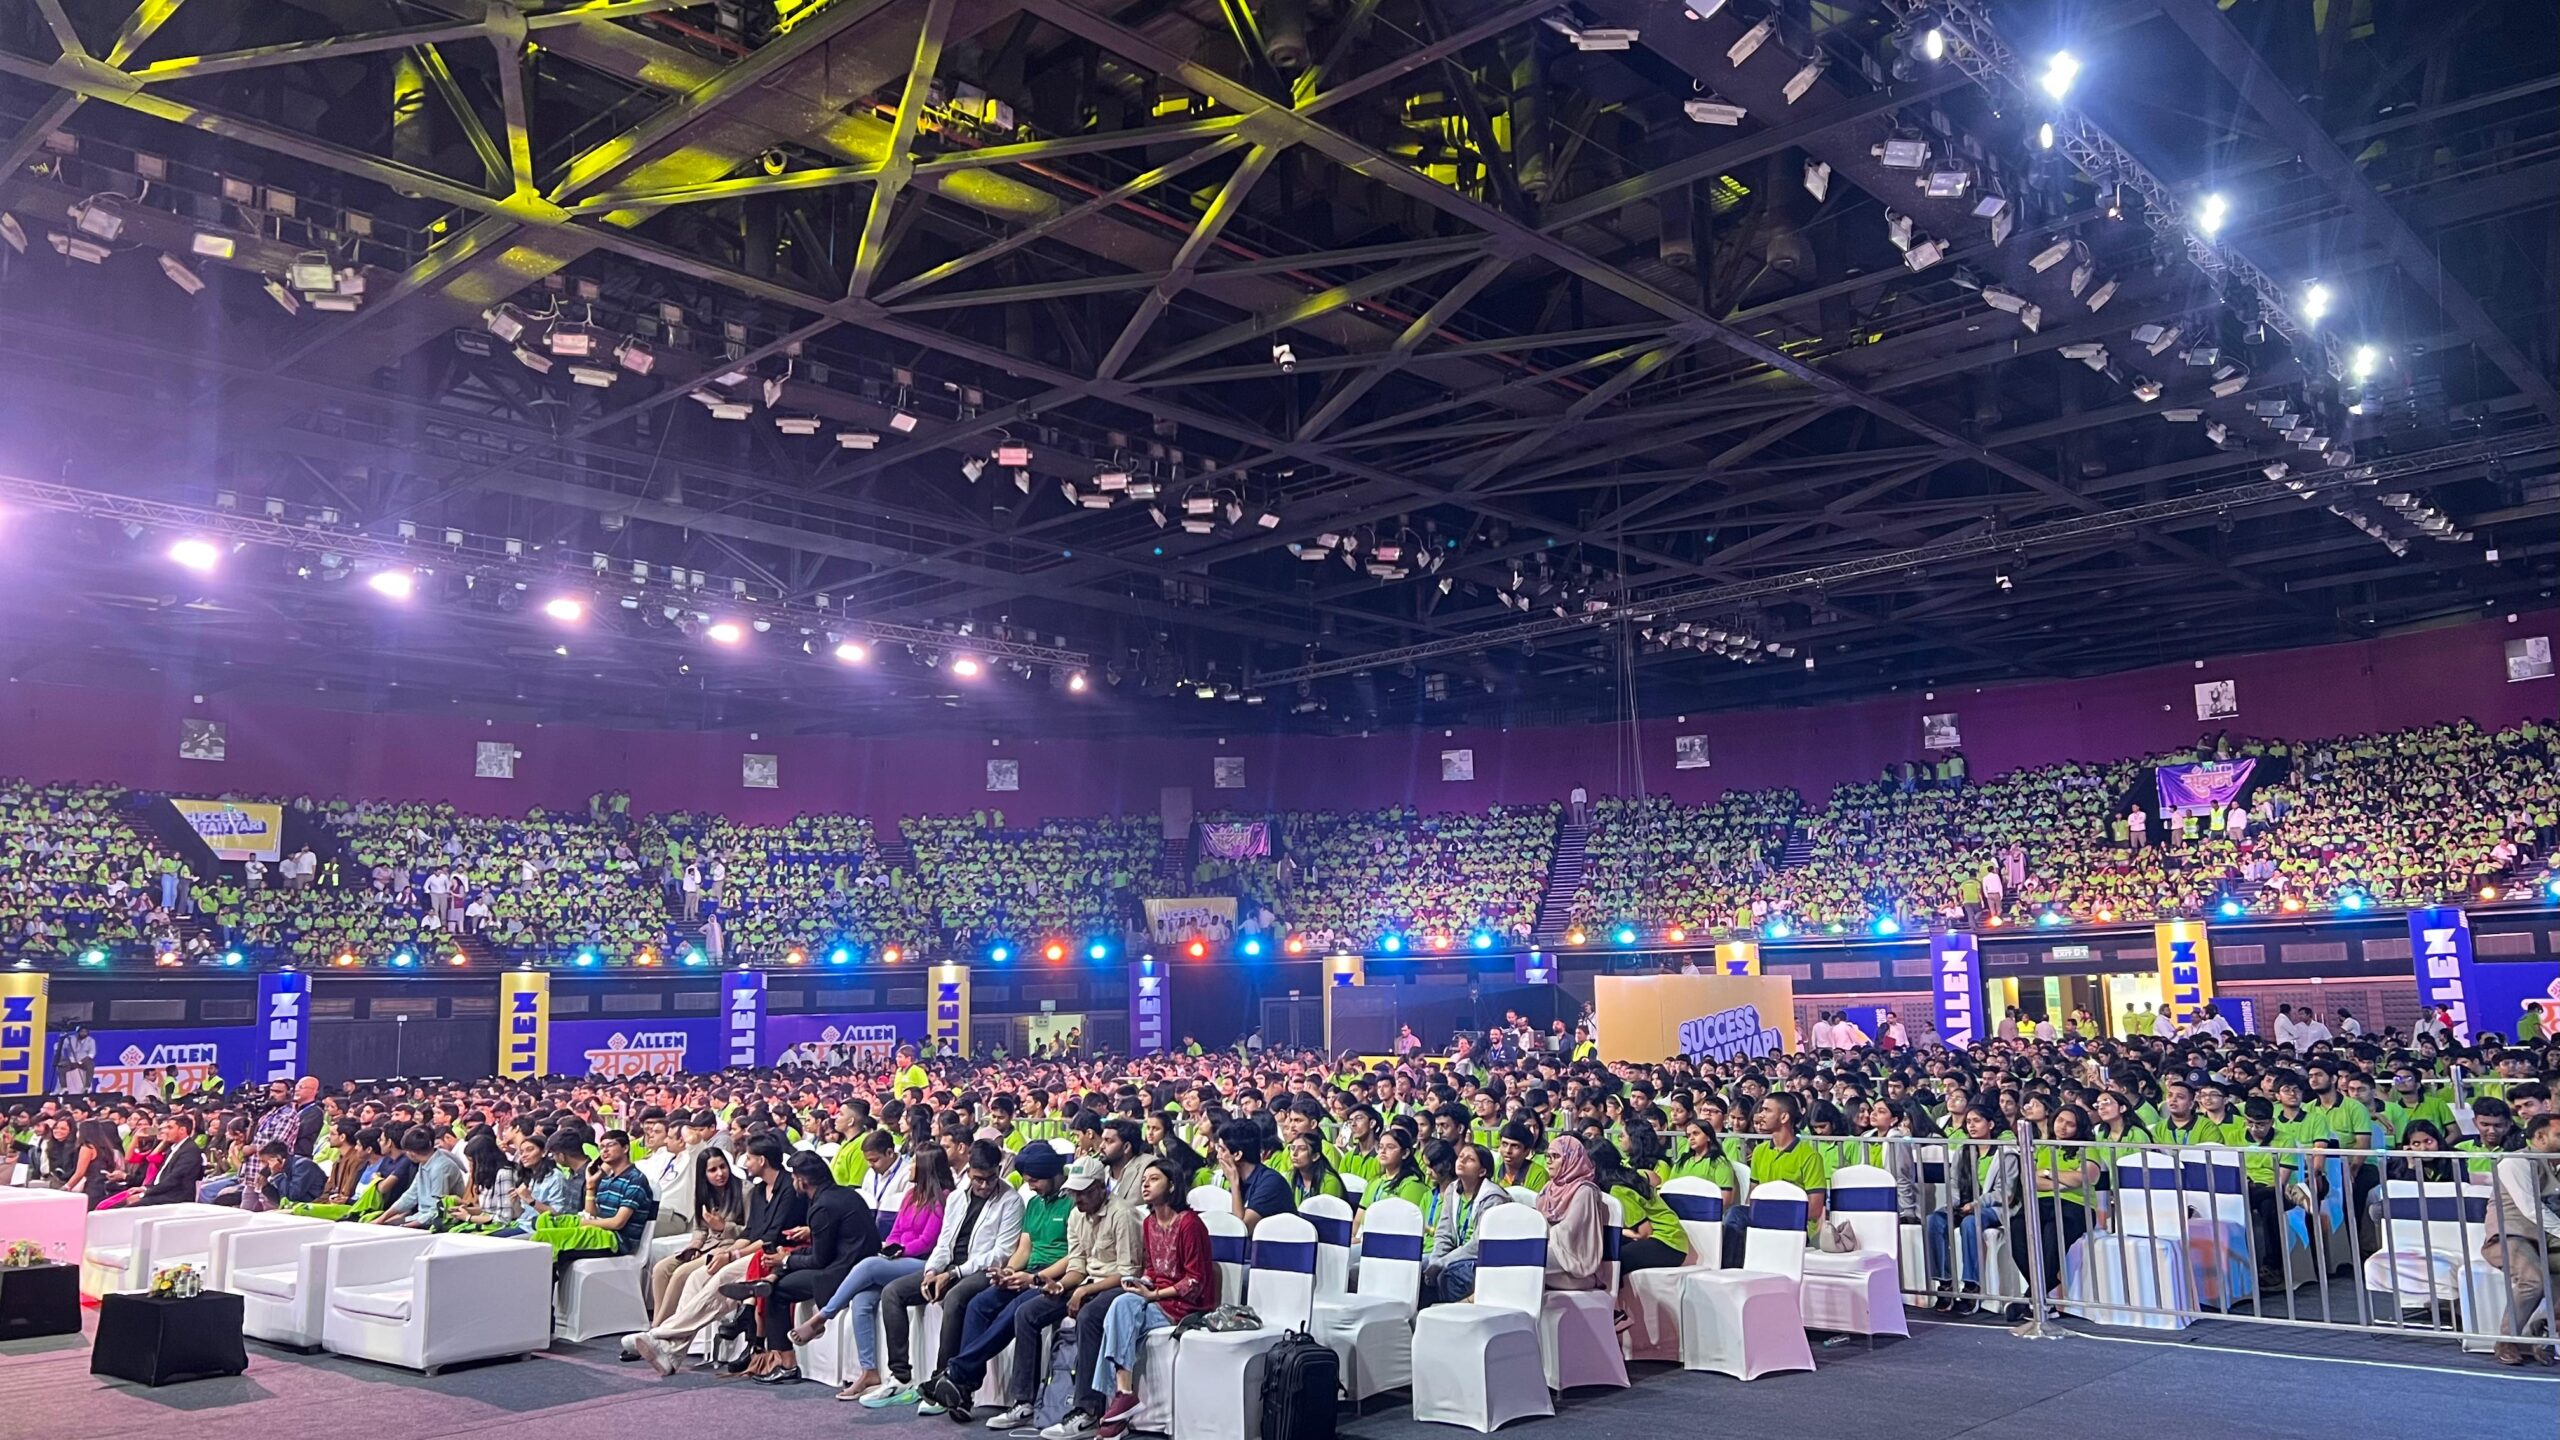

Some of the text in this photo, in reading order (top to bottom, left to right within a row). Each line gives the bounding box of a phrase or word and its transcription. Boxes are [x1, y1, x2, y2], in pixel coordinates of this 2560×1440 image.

[268, 993, 301, 1082] LLEN
[511, 992, 539, 1080] LLEN
[731, 989, 758, 1070] LLEN
[846, 1027, 895, 1040] ALLEN
[1138, 977, 1162, 1055] LLEN
[1680, 1004, 1758, 1056] SUCCESS
[1942, 951, 1972, 1051] ALLEN
[0, 997, 35, 1095] LLEN
[151, 1047, 213, 1064] ALLEN
[633, 1035, 685, 1048] ALLEN
